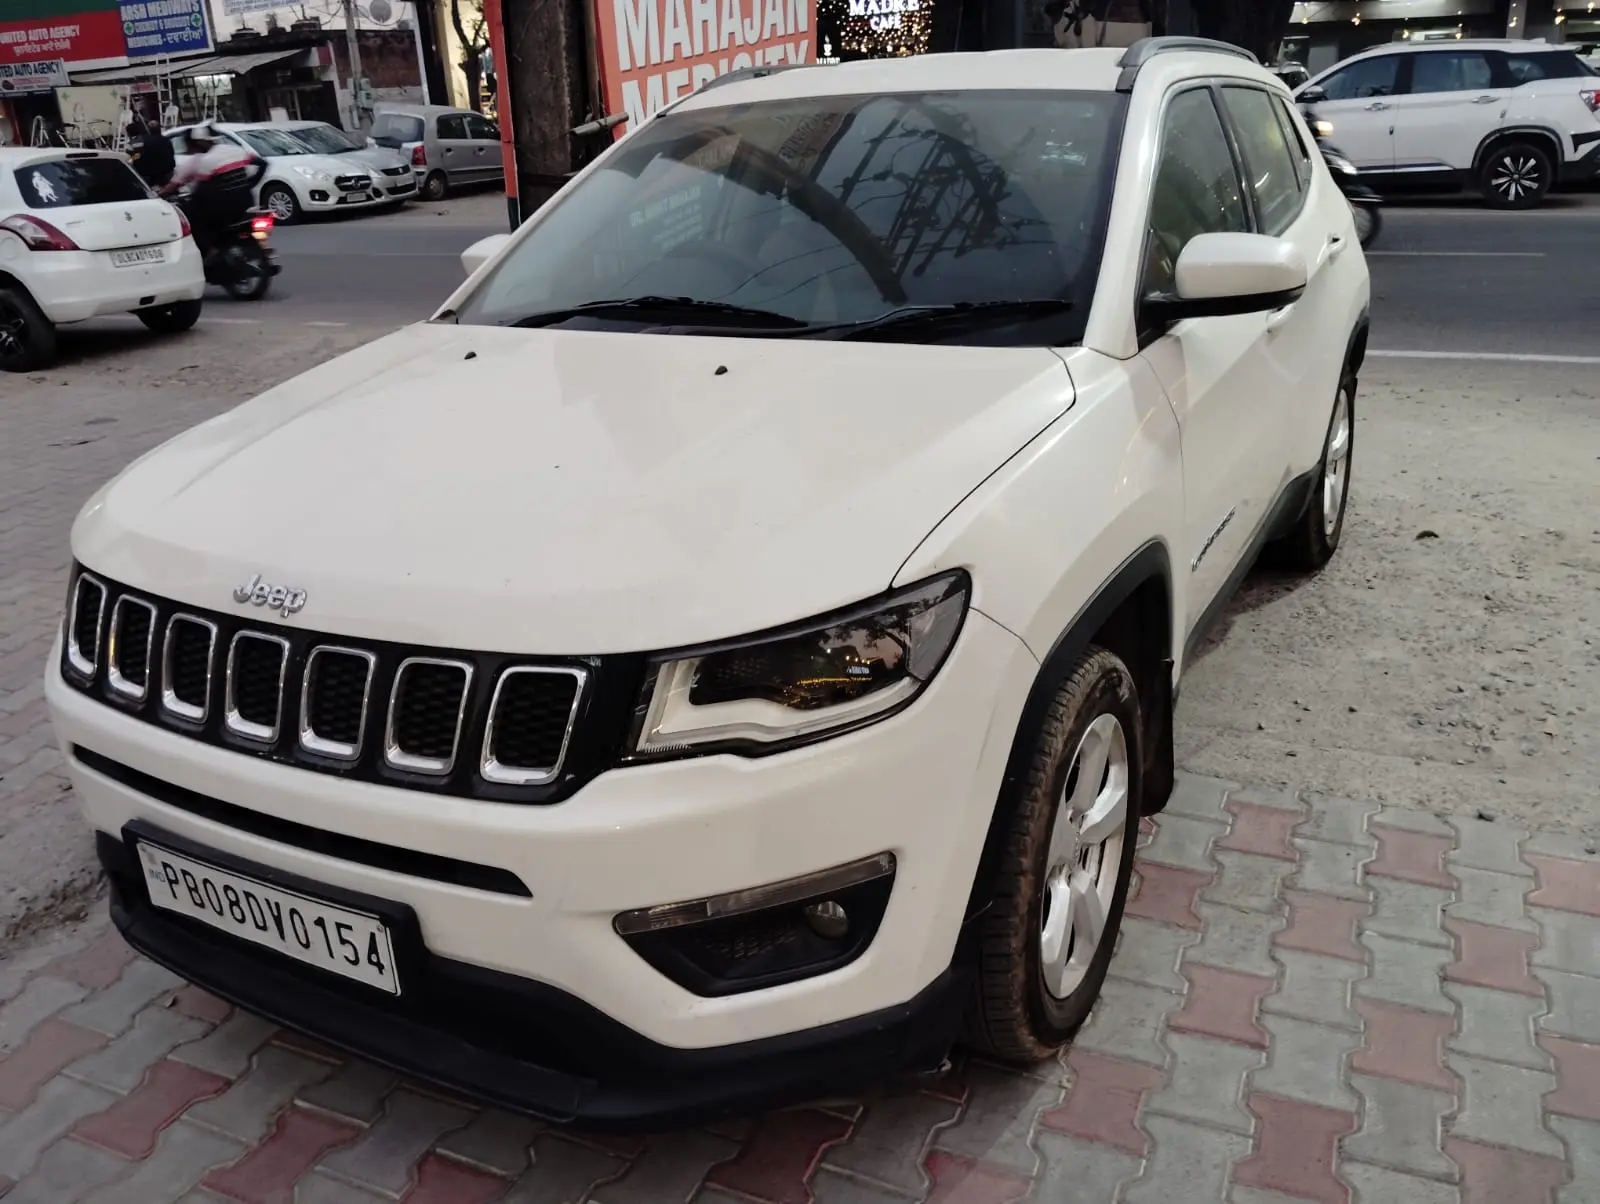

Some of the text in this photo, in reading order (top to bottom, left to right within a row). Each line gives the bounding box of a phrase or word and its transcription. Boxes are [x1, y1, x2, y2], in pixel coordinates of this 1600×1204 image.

[613, 0, 809, 72] MAHAJAN
[233, 573, 307, 619] Jeep
[161, 861, 385, 975] PB08DV0154
